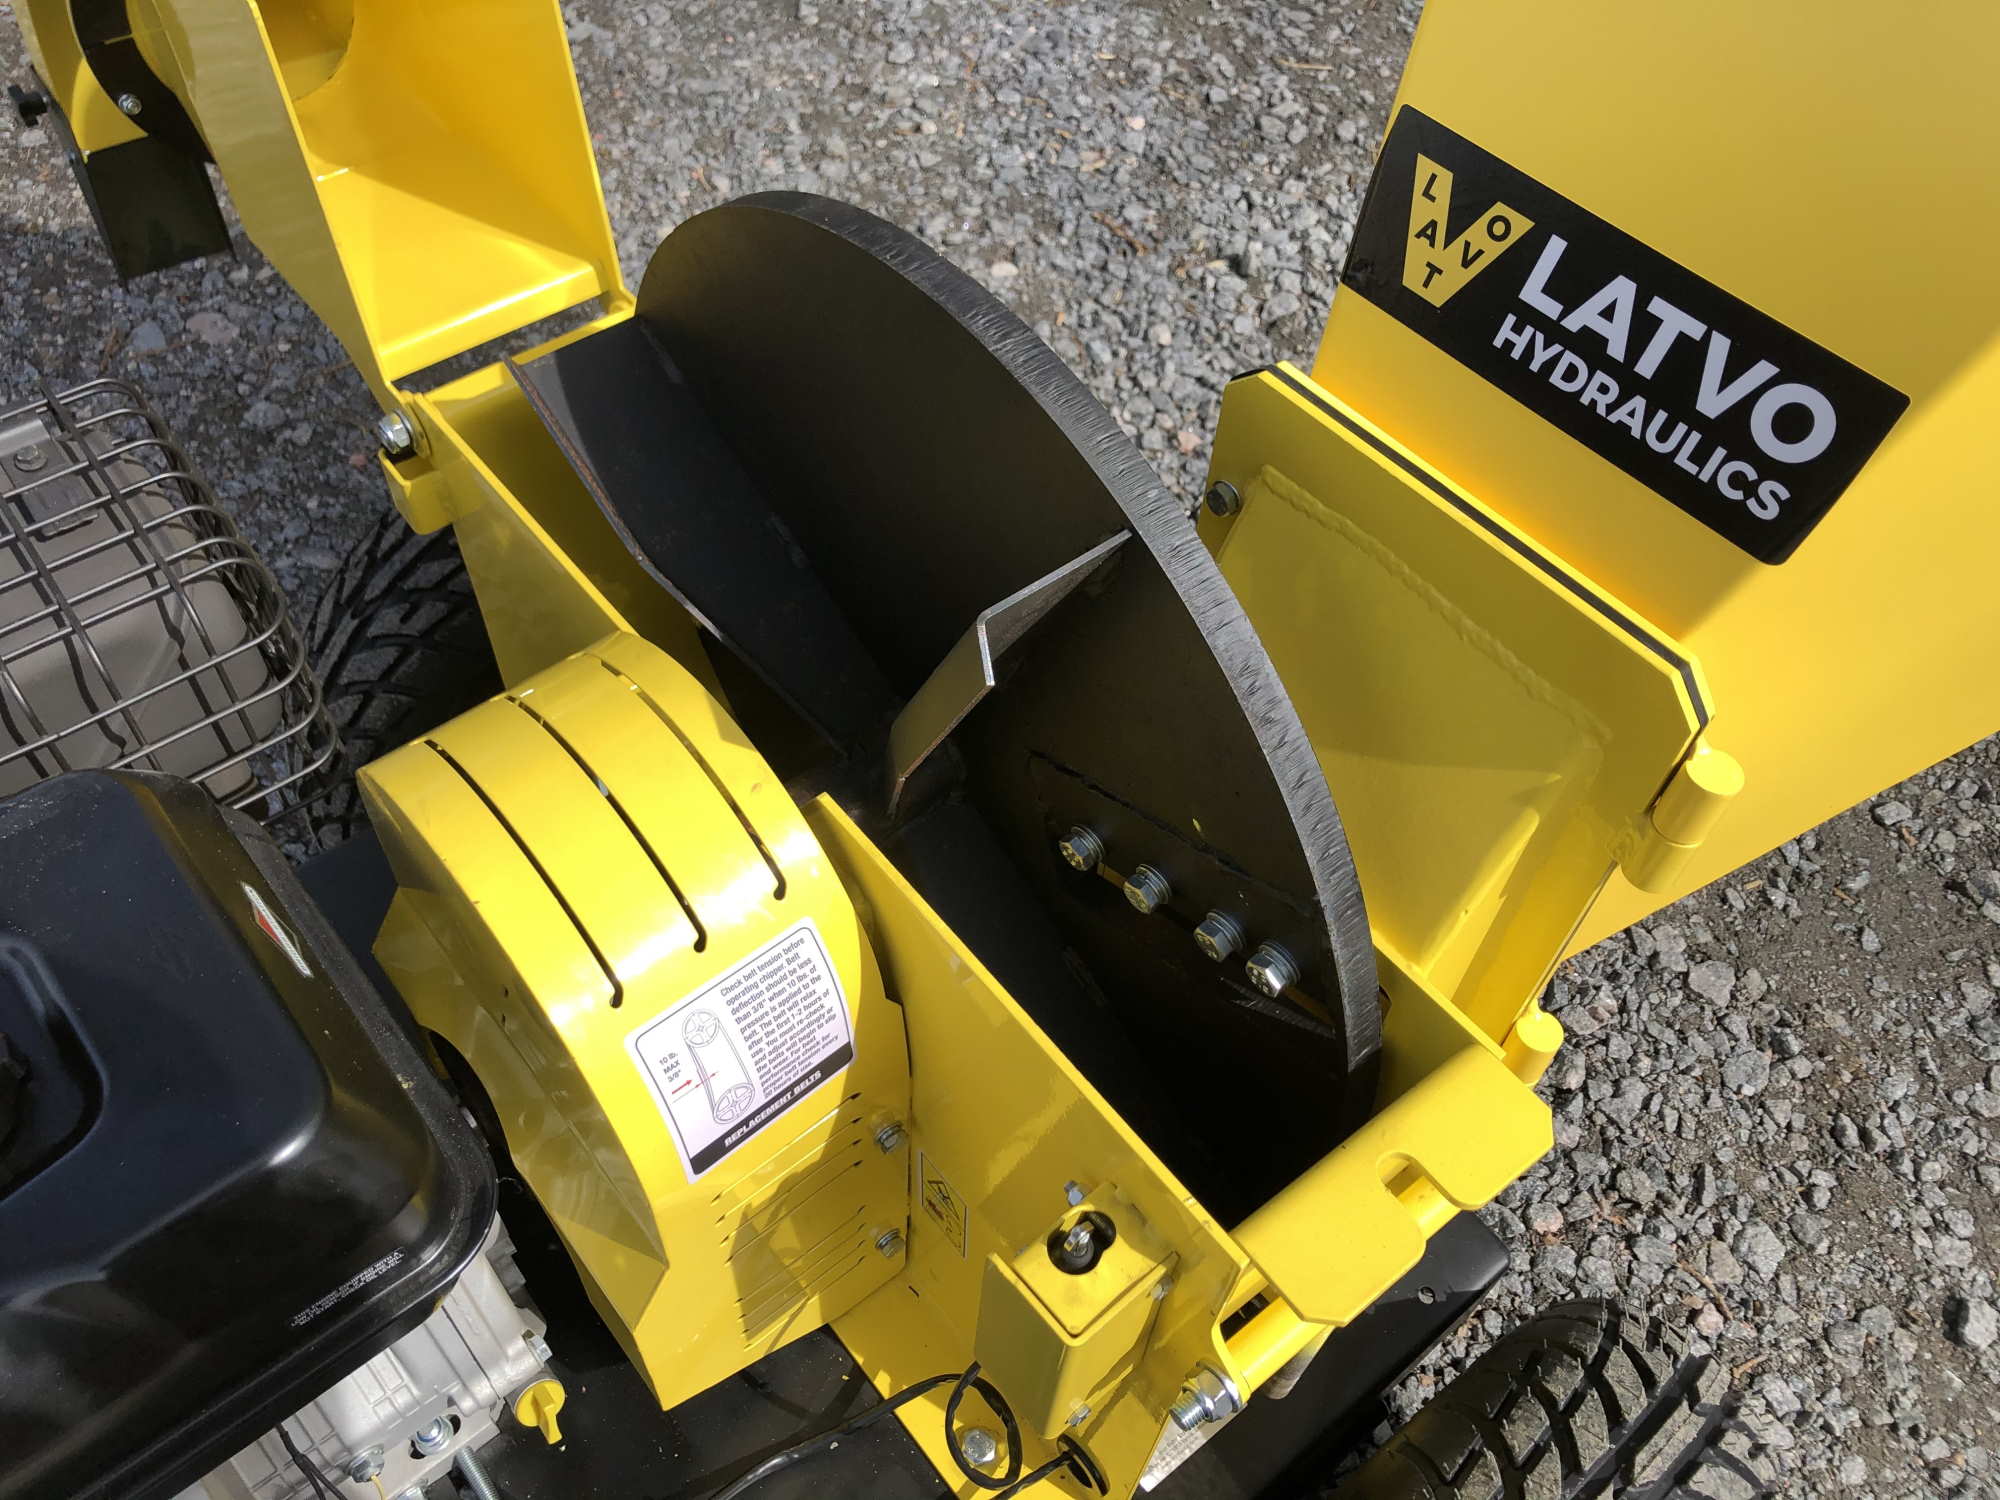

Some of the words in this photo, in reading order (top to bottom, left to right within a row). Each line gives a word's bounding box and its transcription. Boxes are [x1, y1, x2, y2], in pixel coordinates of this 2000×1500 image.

[1518, 233, 1837, 463] LATVO
[1491, 313, 1791, 520] HYDRAULICS
[719, 976, 743, 997] Check
[741, 967, 757, 982] belt
[756, 951, 783, 972] tension
[781, 936, 805, 955] before
[724, 979, 760, 1007] operating
[785, 951, 801, 966] Belt
[729, 988, 765, 1016] deflection
[763, 971, 789, 993] should
[796, 957, 812, 970] less
[734, 1009, 752, 1025] than
[767, 986, 787, 1002] when
[795, 971, 809, 983] lbs.
[739, 1009, 770, 1035] pressure
[777, 986, 802, 1007] applied
[809, 974, 822, 985] the
[746, 1035, 764, 1051] after
[763, 1027, 776, 1038] the
[801, 995, 822, 1011] hours
[759, 1019, 773, 1031] The
[771, 1008, 787, 1022] belt
[799, 988, 817, 1003] relax
[662, 1059, 680, 1074] MAX
[753, 1052, 767, 1066] and
[765, 1036, 778, 1047] You
[723, 1090, 793, 1147] REPLACEMENT
[792, 1069, 823, 1095] BELTS
